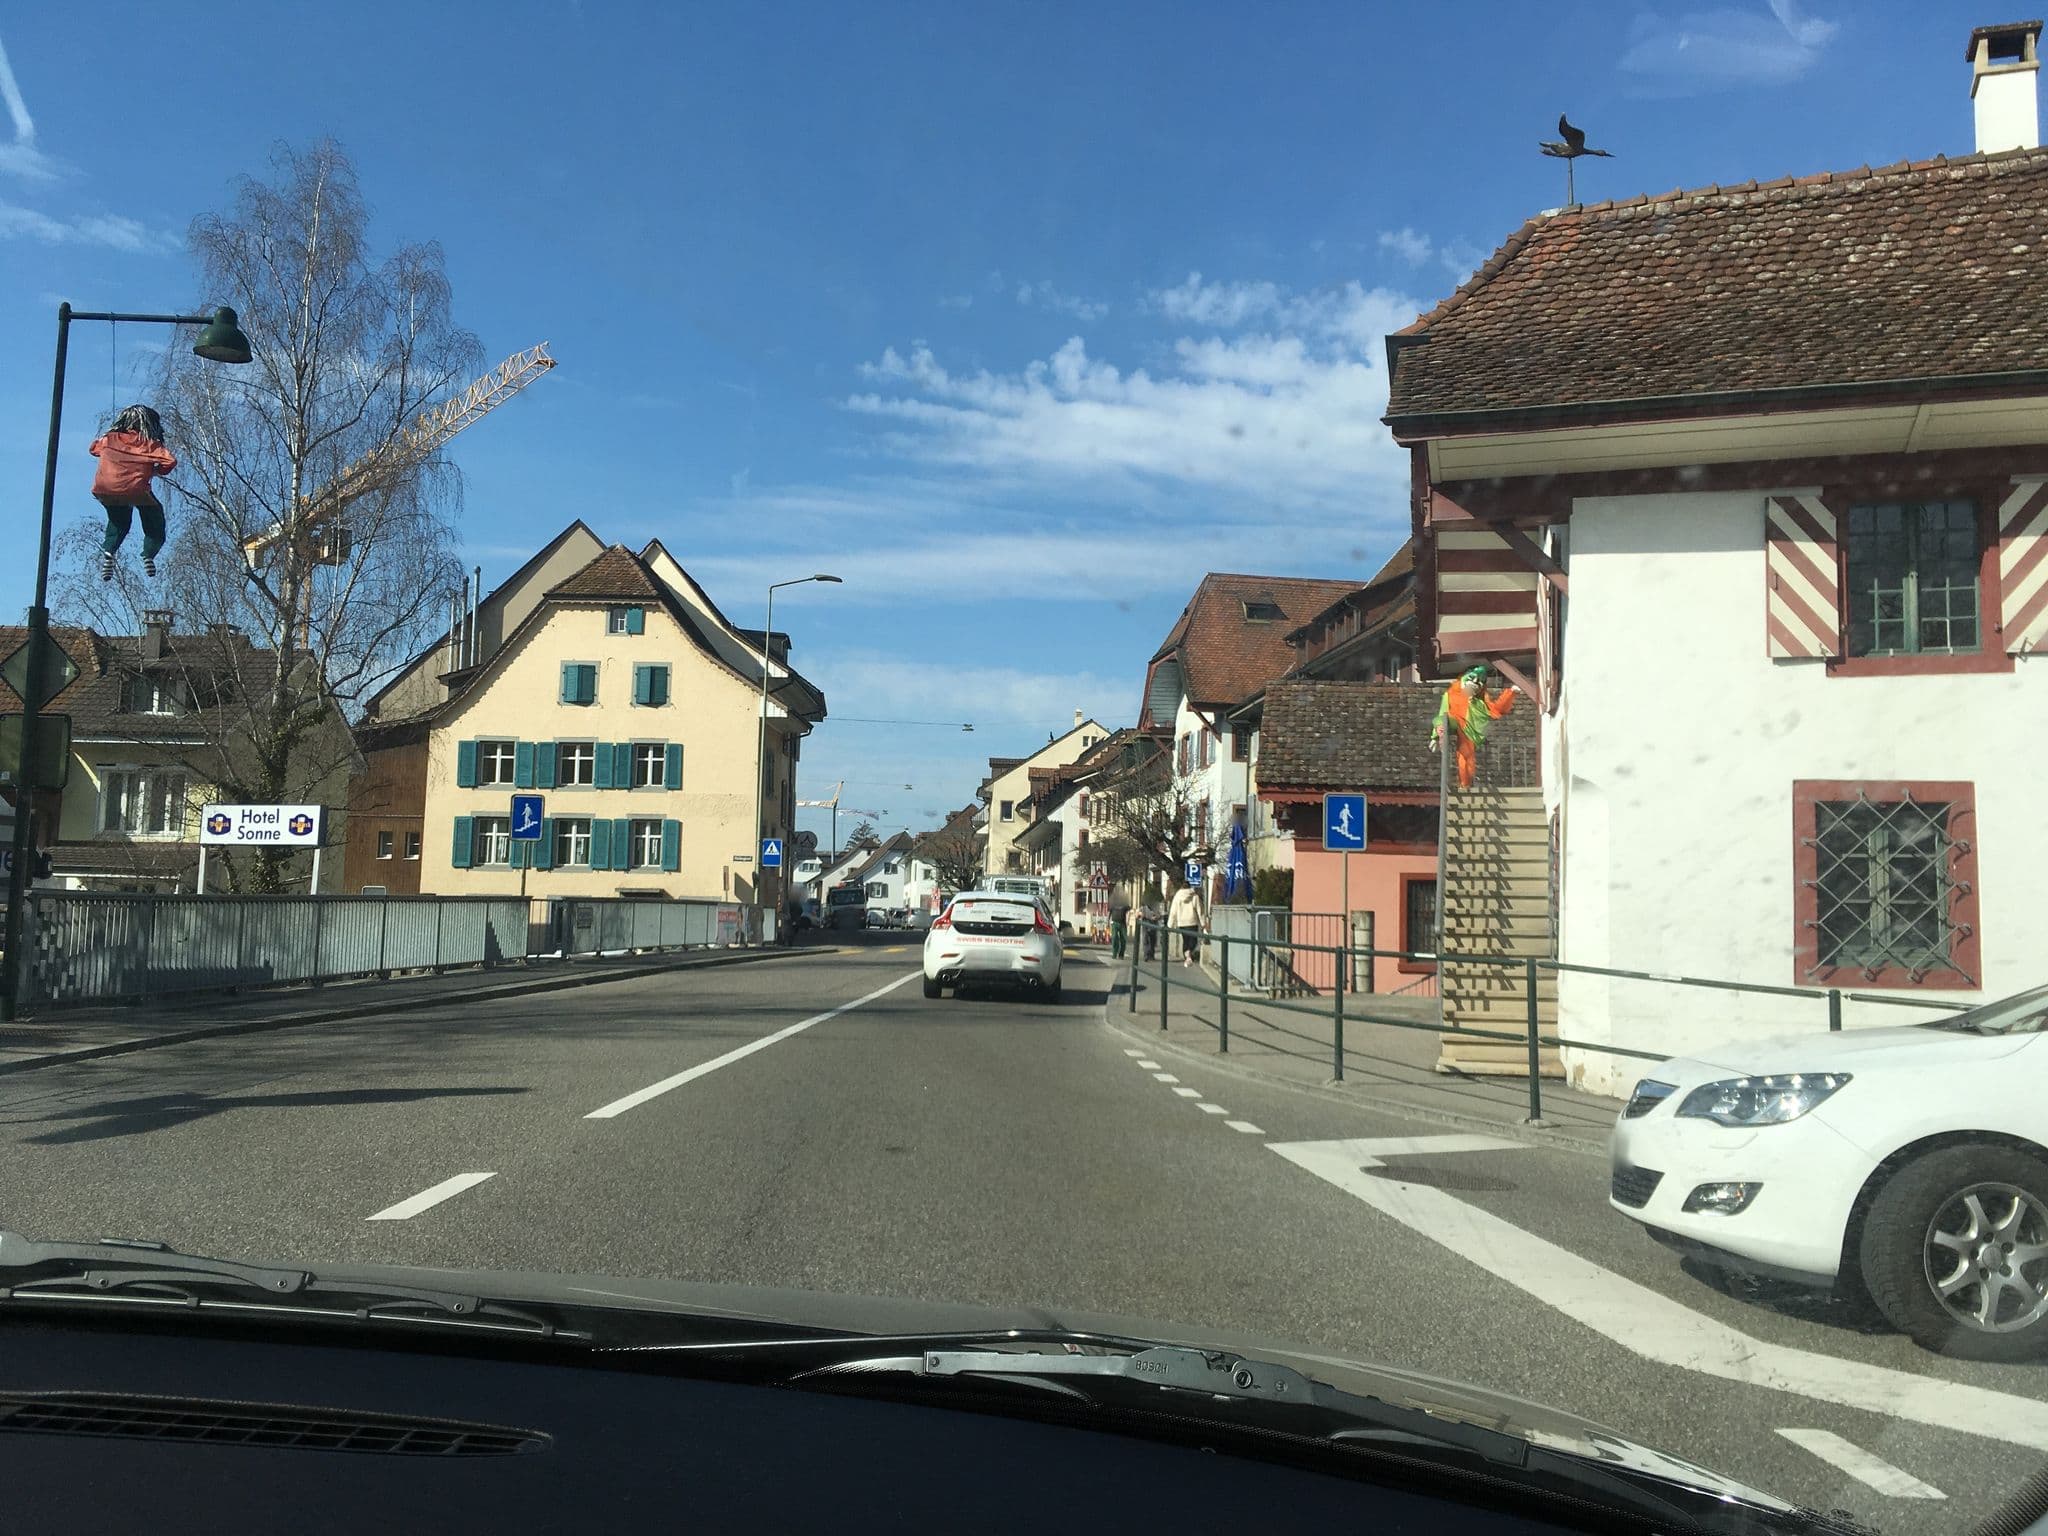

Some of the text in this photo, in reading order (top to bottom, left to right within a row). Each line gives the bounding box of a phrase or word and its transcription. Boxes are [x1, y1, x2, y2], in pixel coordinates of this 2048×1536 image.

[241, 808, 280, 824] Hotel
[237, 826, 281, 840] Sonne
[1189, 865, 1199, 877] P
[1135, 1360, 1169, 1374] BOSCH
